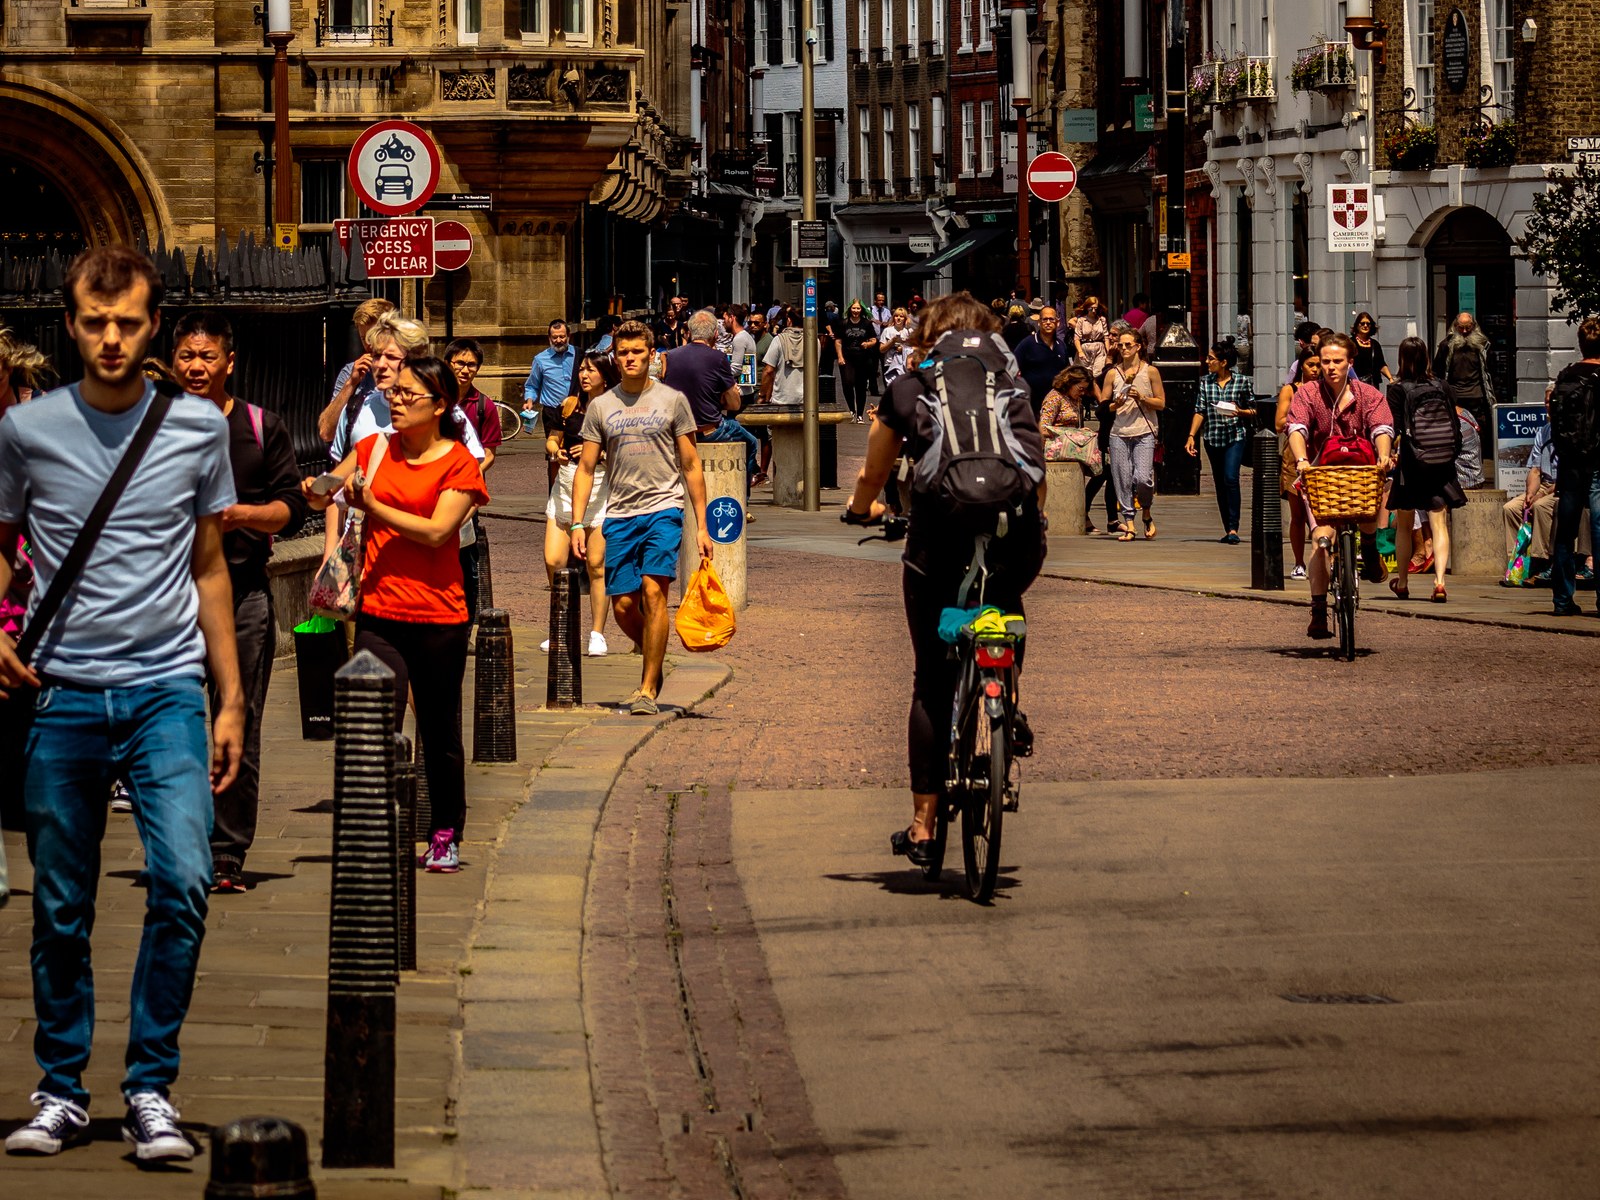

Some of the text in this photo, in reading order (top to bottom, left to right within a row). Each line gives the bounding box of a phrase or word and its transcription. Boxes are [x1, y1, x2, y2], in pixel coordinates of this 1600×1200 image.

[383, 256, 428, 270] CLEAR
[605, 409, 668, 435] Superdry
[1506, 411, 1537, 422] CLIMB
[1512, 424, 1539, 435] TOW
